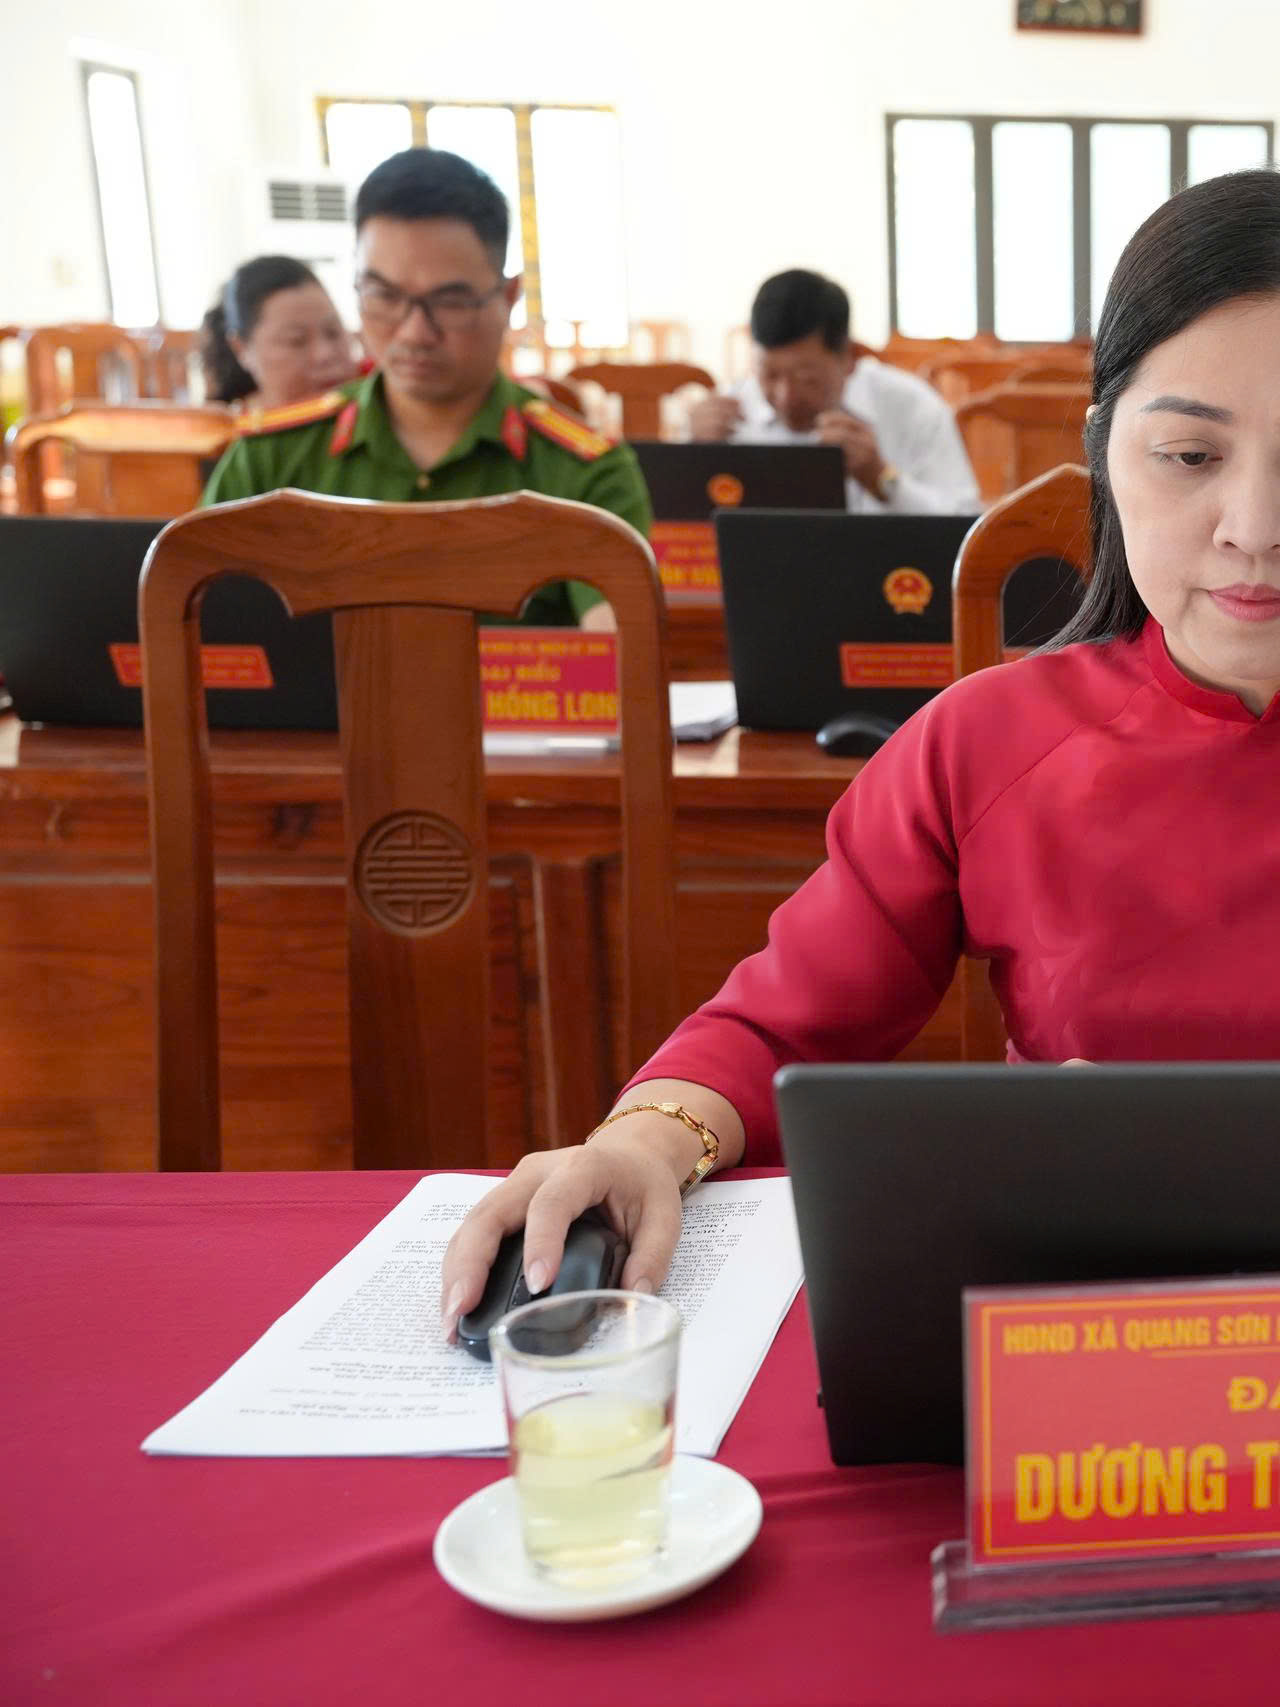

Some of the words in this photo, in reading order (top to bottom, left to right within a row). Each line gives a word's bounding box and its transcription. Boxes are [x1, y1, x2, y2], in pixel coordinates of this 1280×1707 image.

[565, 690, 617, 720] LON
[1124, 1316, 1211, 1351] QUANG
[1217, 1311, 1271, 1345] SƠN
[1015, 1442, 1229, 1524] DƯƠNG
